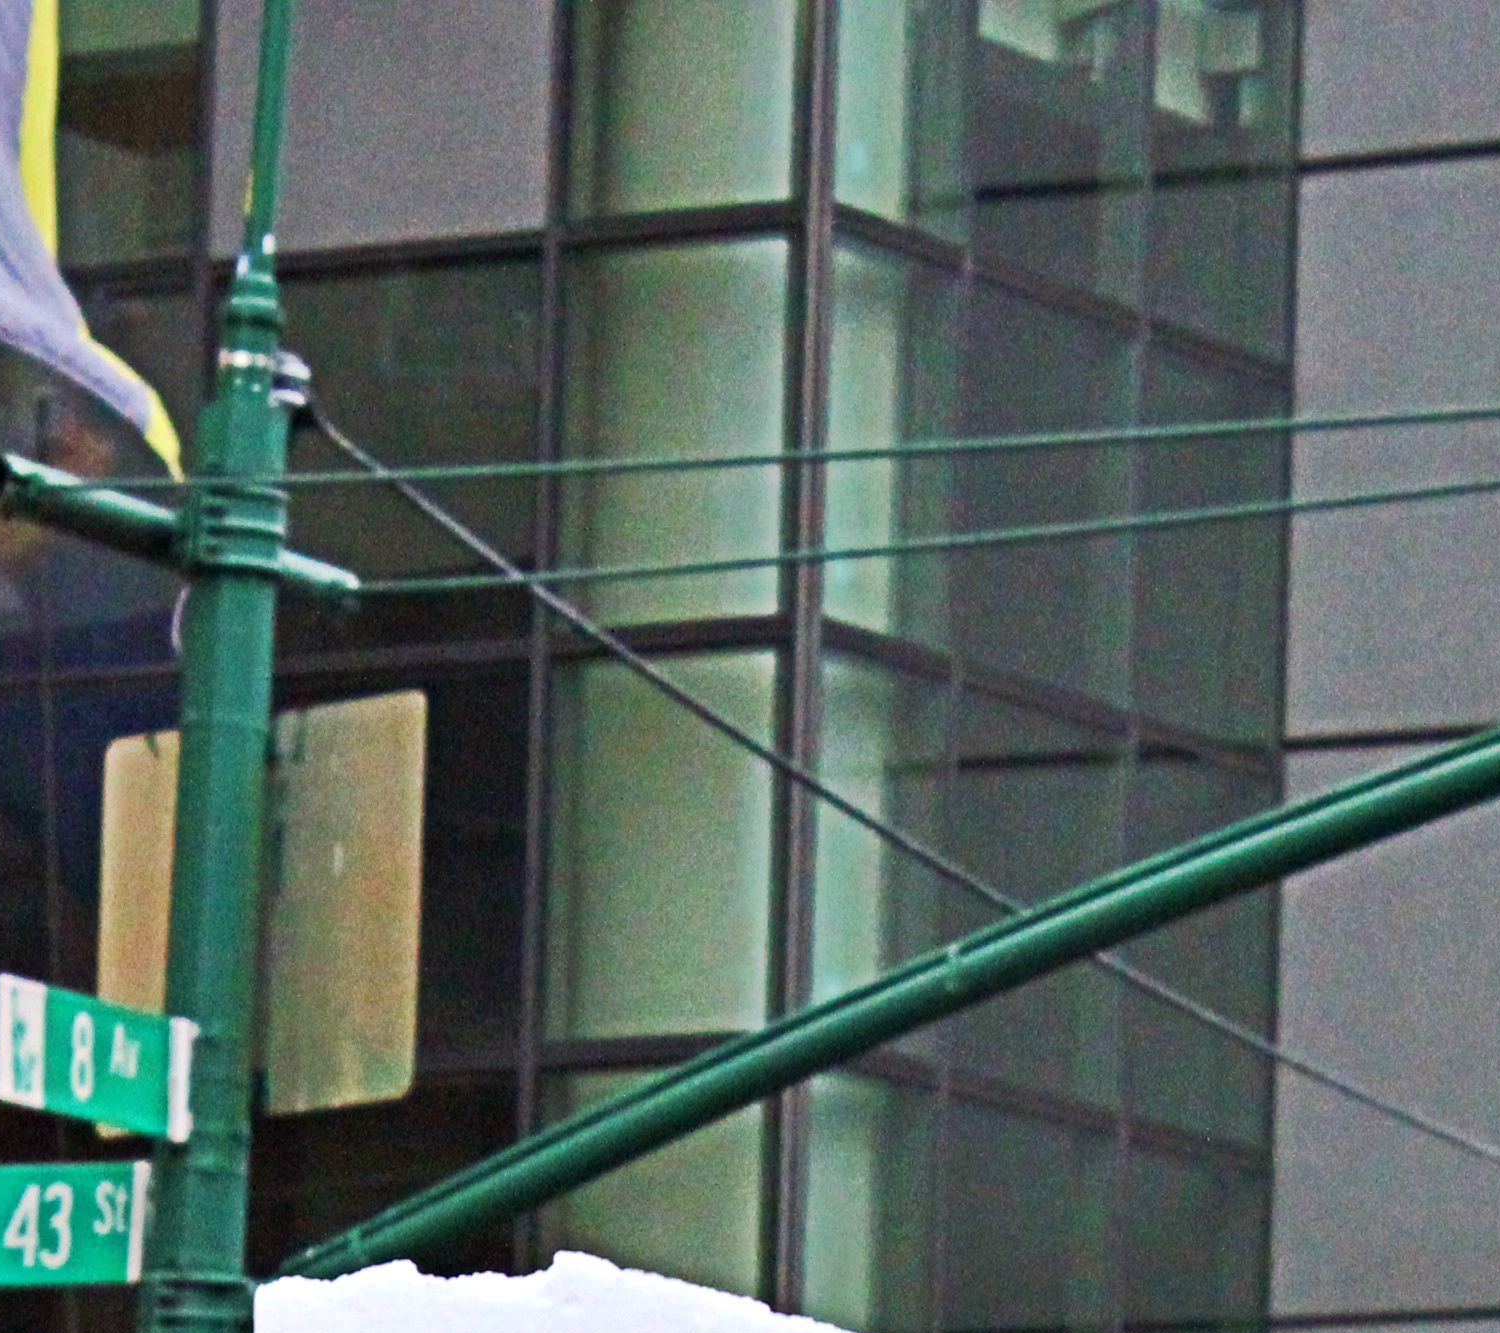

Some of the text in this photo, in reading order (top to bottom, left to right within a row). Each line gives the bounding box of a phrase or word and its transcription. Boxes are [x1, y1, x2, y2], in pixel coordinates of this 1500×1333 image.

[70, 1010, 95, 1102] 8
[3, 1182, 74, 1270] 43
[93, 1180, 128, 1236] St
